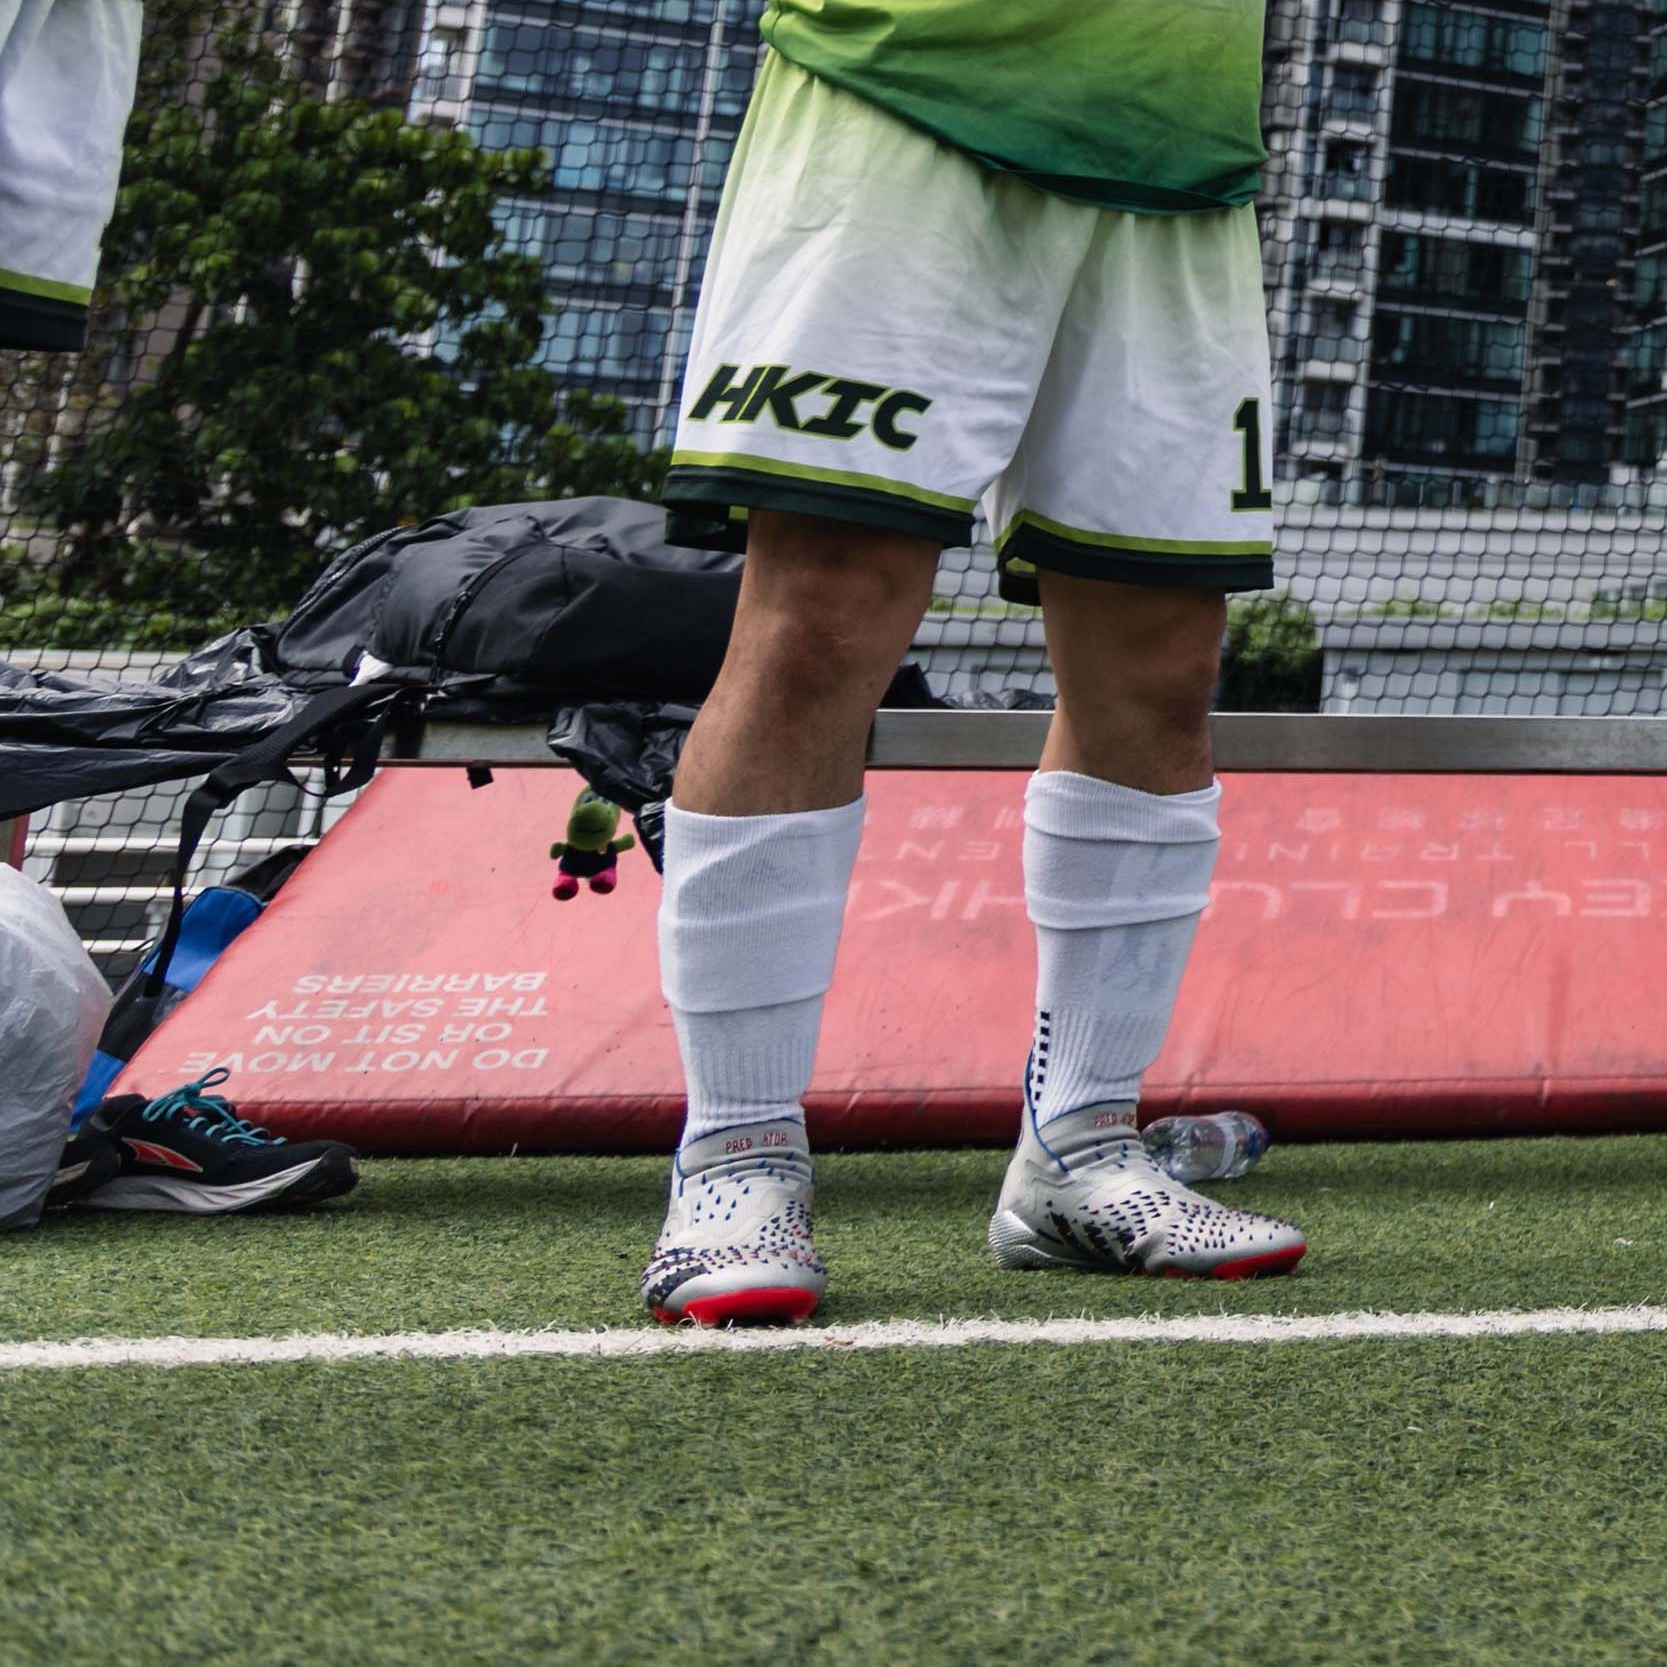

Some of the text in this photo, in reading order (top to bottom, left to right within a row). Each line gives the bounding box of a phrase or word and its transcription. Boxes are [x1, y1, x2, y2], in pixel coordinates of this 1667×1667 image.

[688, 363, 932, 452] HKIC
[1230, 397, 1273, 512] 1
[1234, 841, 1516, 862] TRAINI
[1202, 880, 1450, 920] CLU
[292, 973, 548, 995] BARRIERS
[247, 997, 550, 1020] THE SAFETY
[251, 1021, 513, 1046] OR SIT ON
[179, 1047, 550, 1074] DO NOT MOVE
